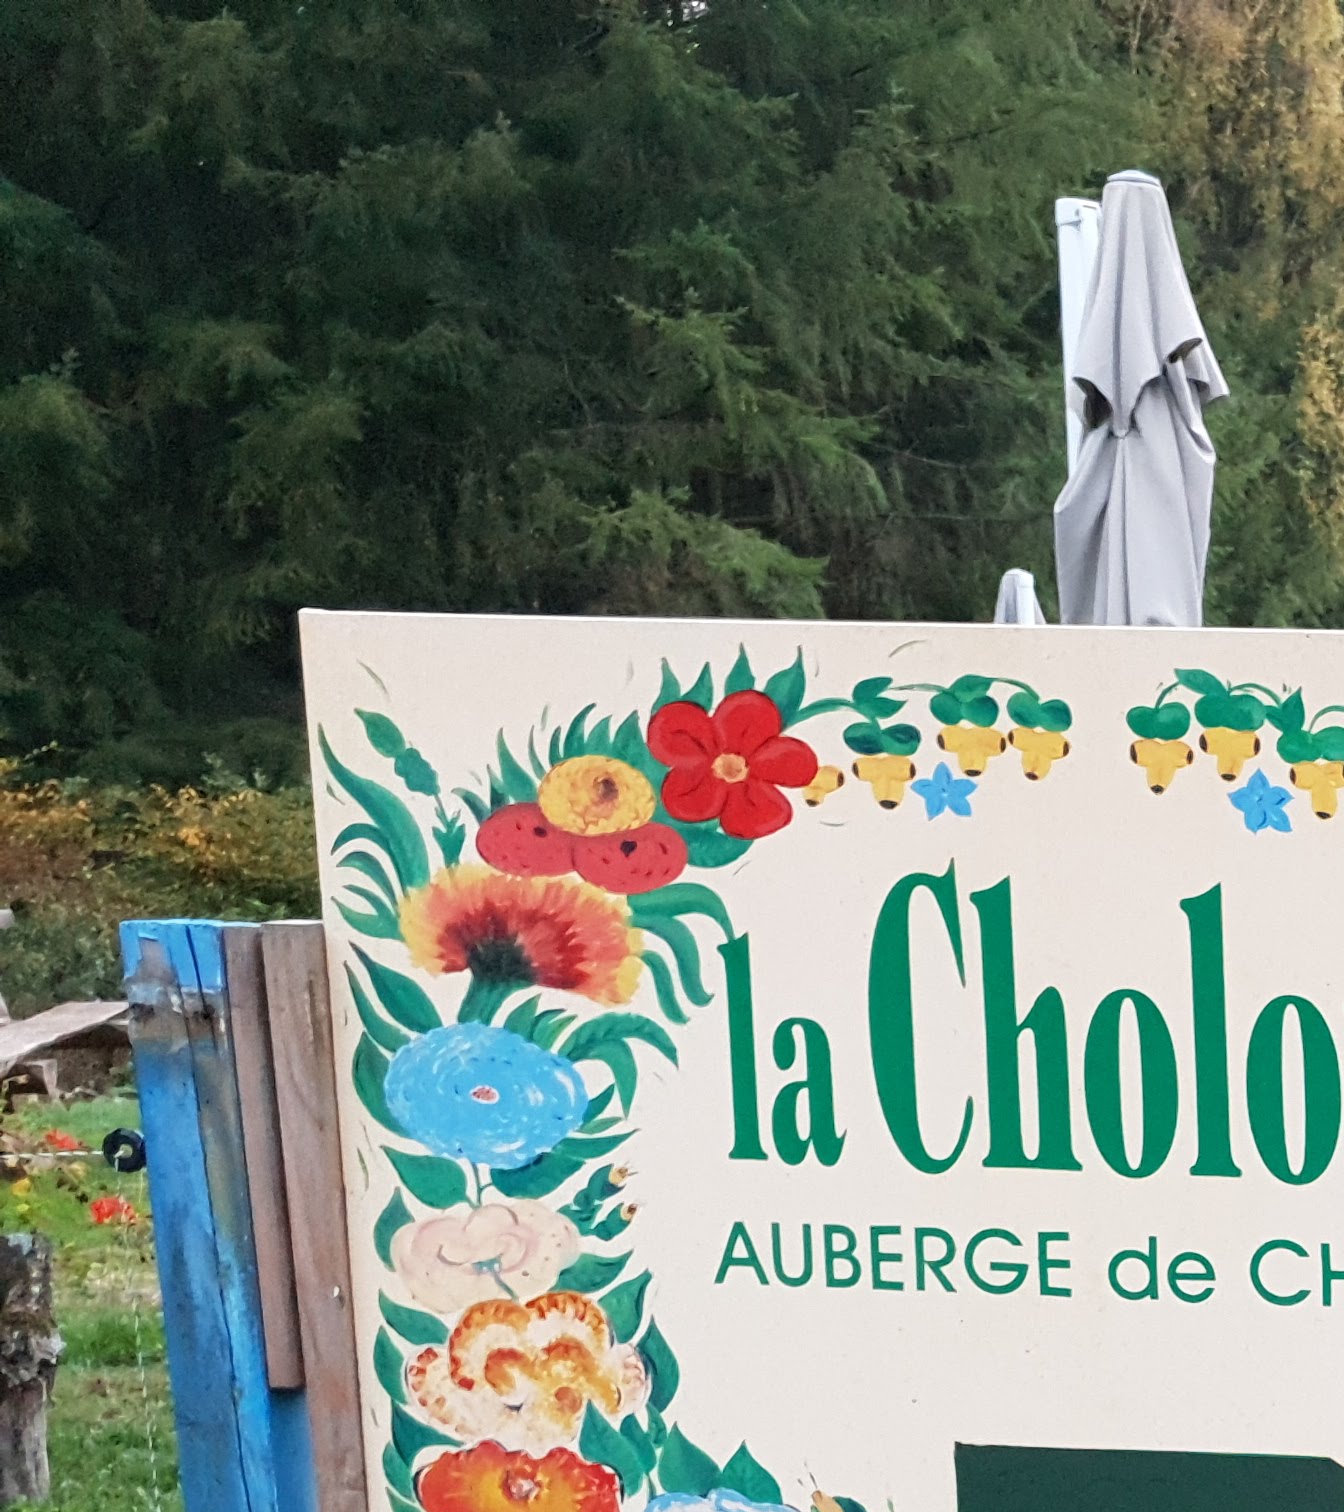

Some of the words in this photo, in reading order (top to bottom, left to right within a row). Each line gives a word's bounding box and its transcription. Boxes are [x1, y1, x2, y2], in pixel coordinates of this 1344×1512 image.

[721, 932, 846, 1167] la
[714, 1221, 1073, 1298] AUBERGE
[1107, 1236, 1216, 1303] de
